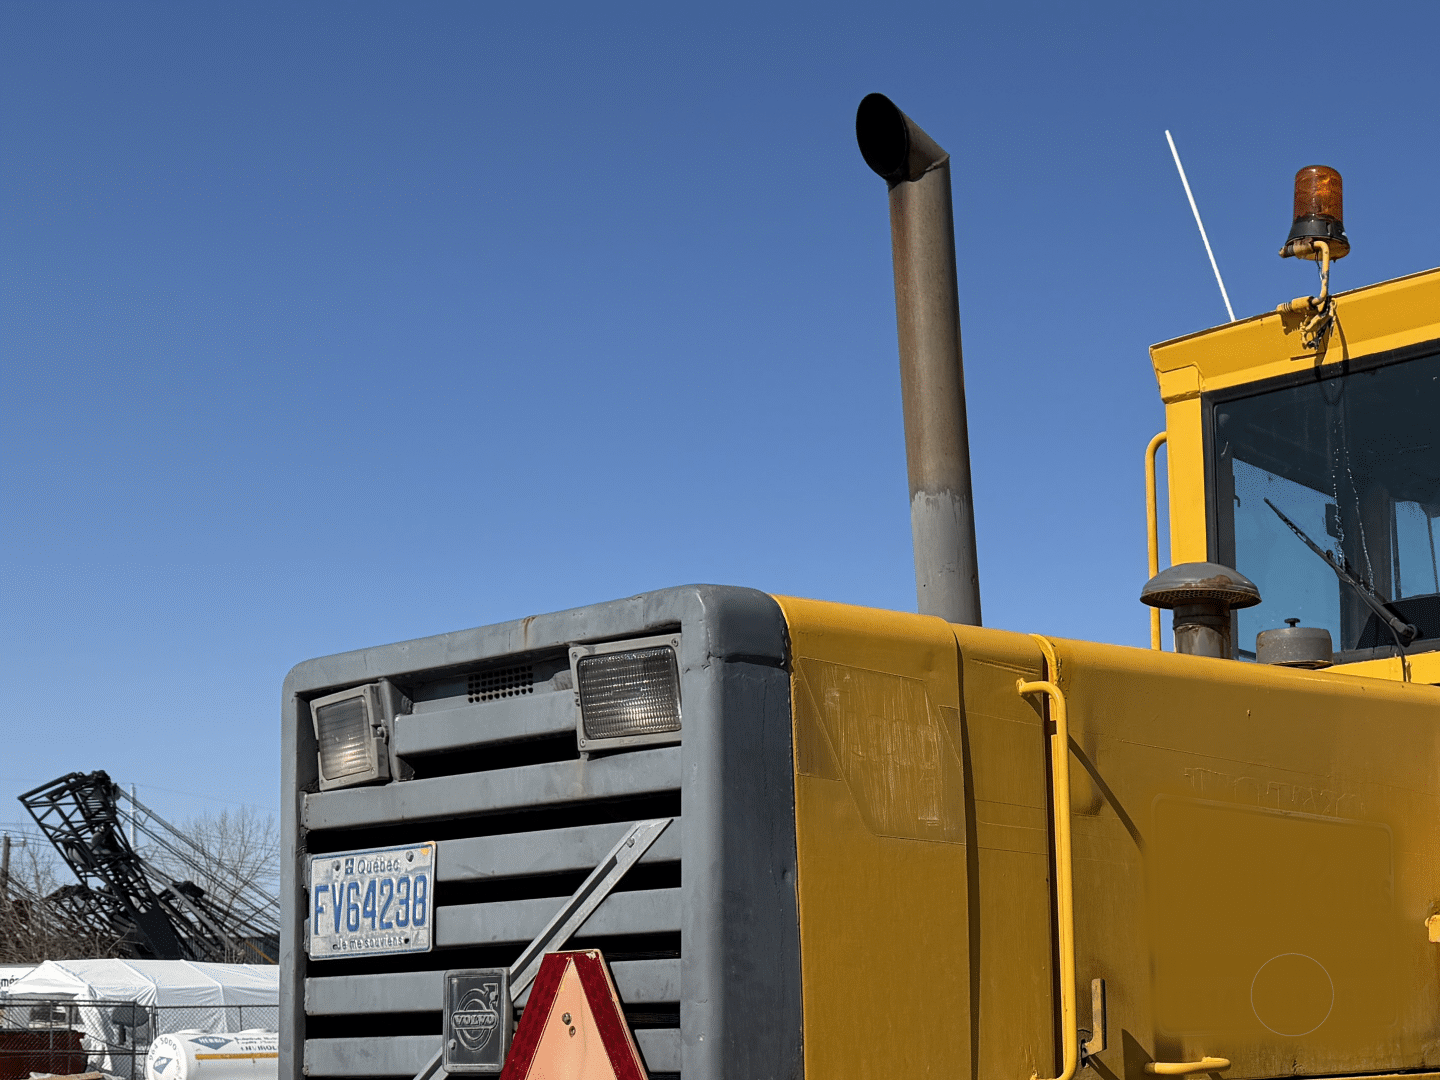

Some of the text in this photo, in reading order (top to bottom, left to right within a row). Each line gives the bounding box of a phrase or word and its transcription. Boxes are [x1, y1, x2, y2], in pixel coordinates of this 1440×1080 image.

[357, 856, 400, 874] Québec
[315, 874, 428, 936] FV64238
[350, 938, 363, 950] me
[364, 935, 404, 948] souviens
[453, 1014, 496, 1026] VOLVO
